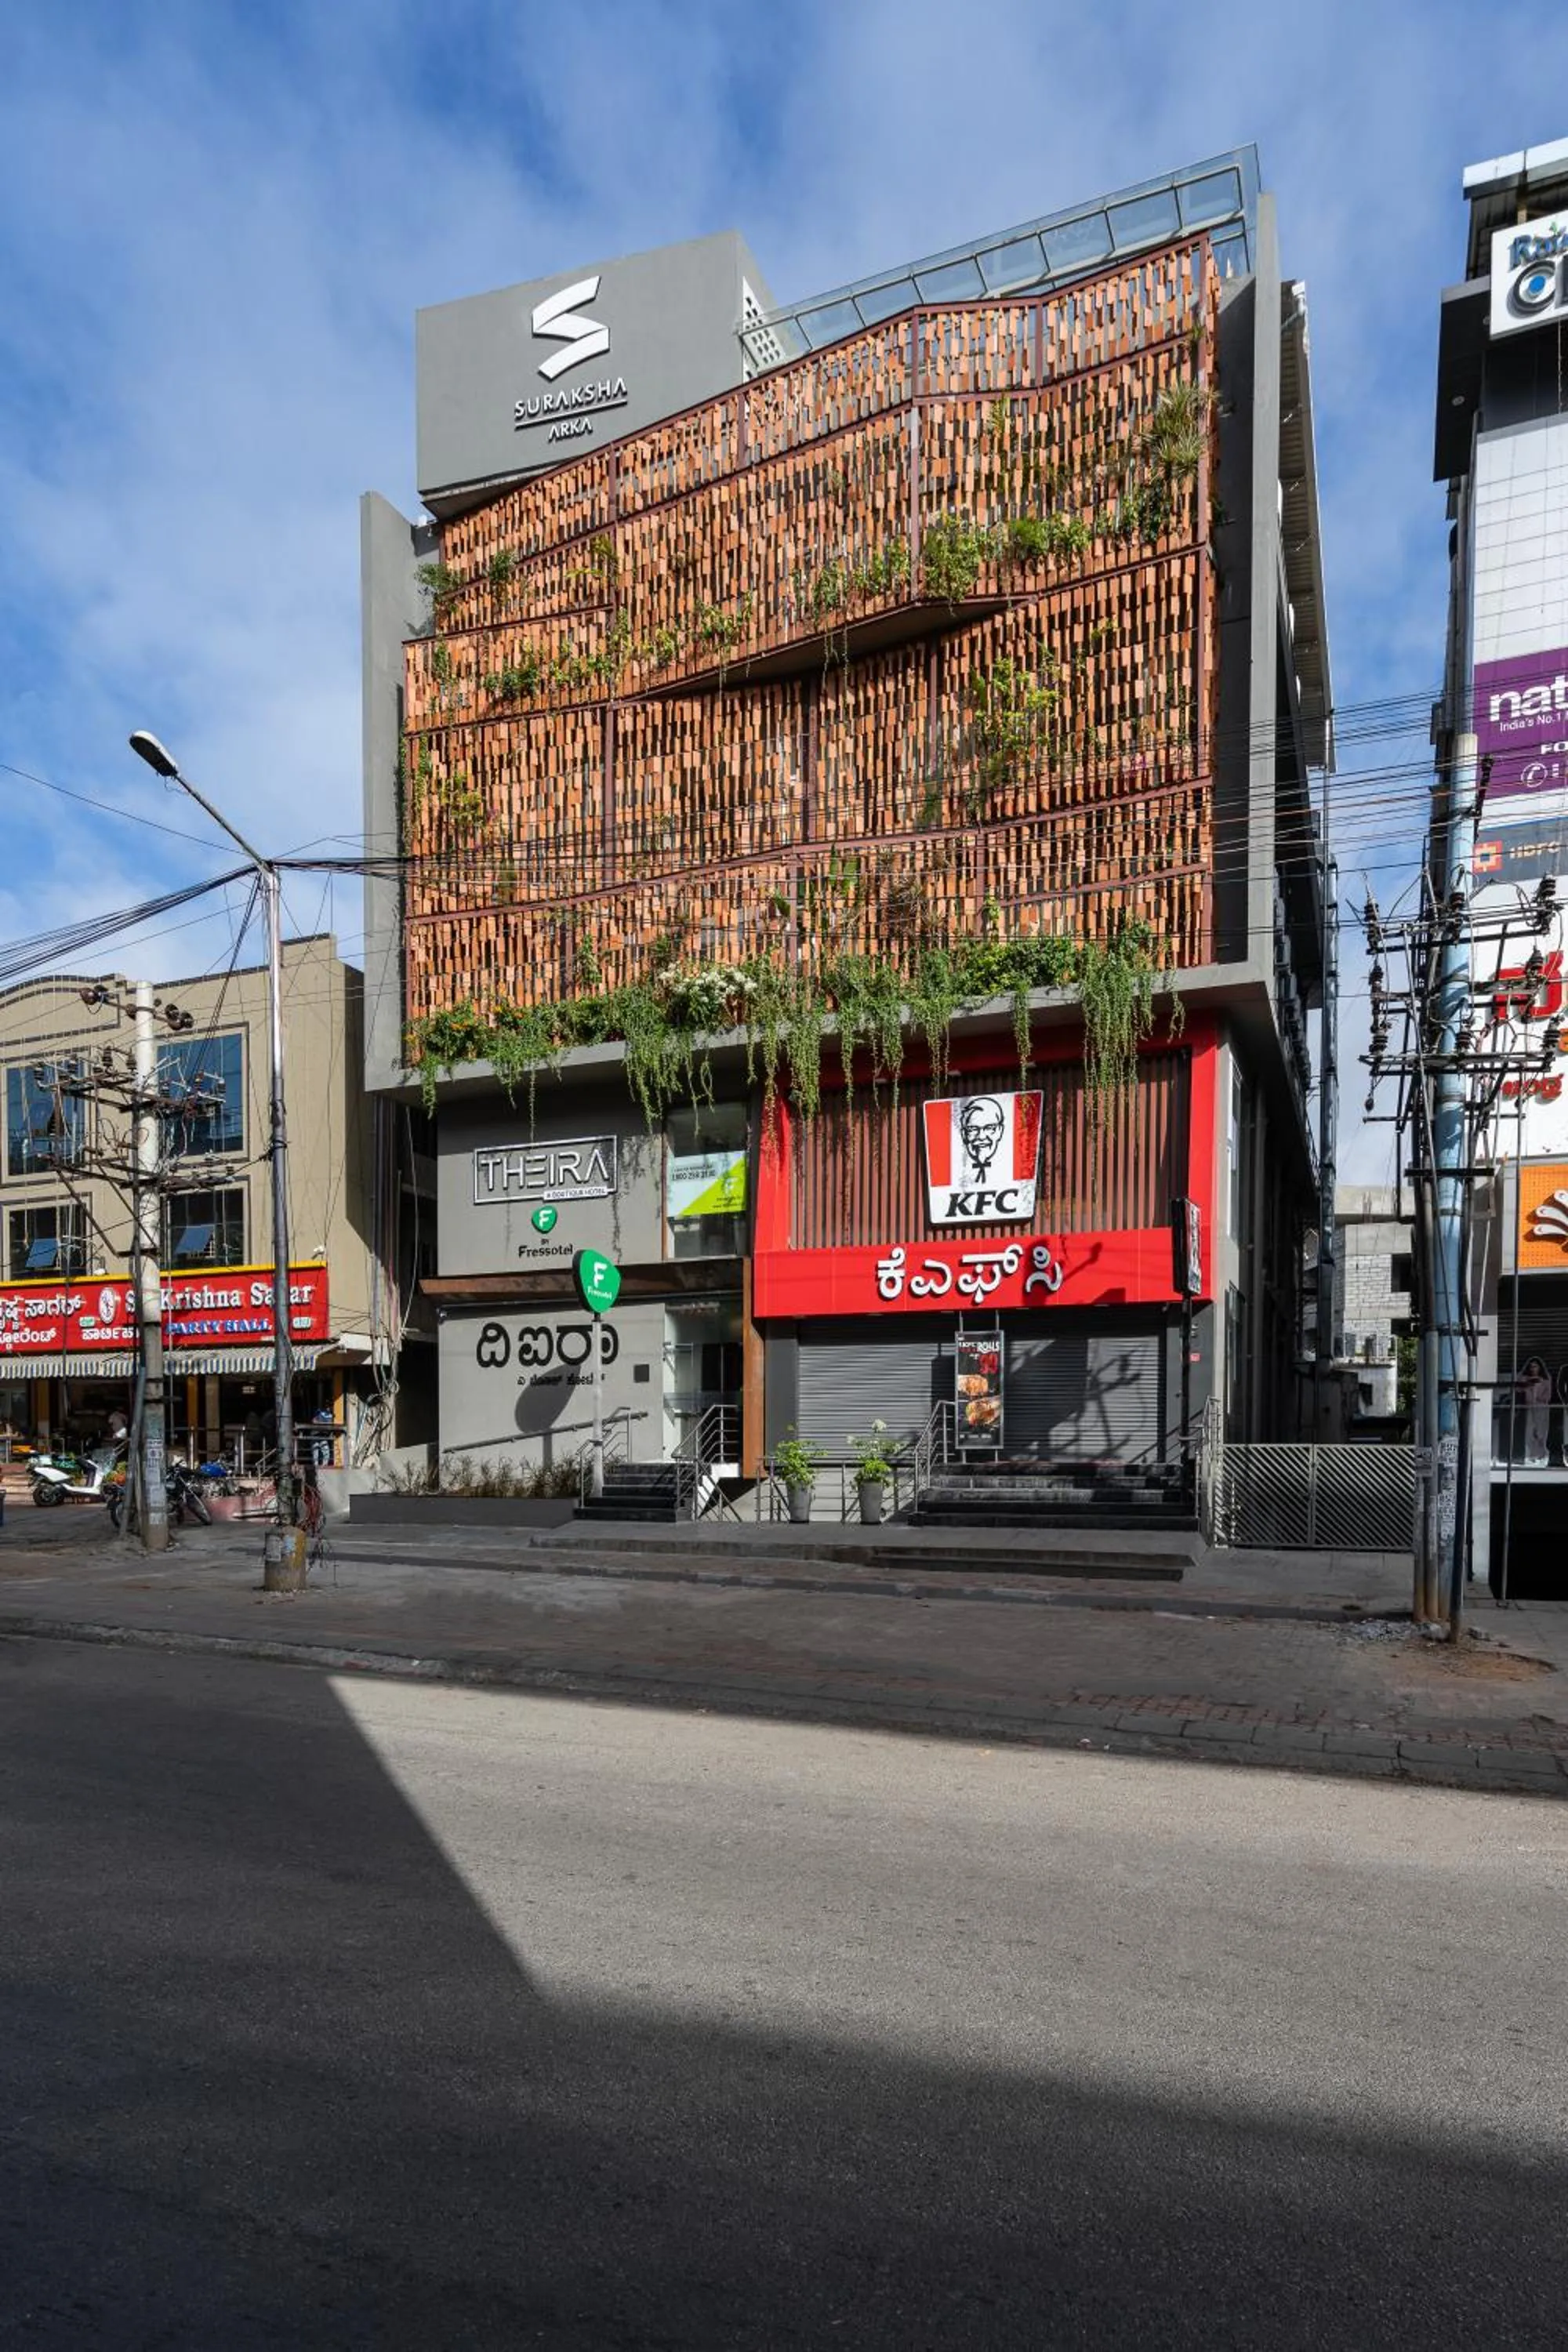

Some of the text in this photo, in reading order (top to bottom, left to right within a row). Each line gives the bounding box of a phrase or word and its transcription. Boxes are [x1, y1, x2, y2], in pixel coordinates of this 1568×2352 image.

[514, 377, 627, 420] SURAKSHA
[549, 418, 593, 442] ARKA
[1500, 712, 1561, 732] India's No.1
[481, 1149, 609, 1191] THEIRA
[946, 1189, 1018, 1217] KFC
[518, 1243, 573, 1258] Fressotel
[160, 1286, 242, 1310] Krishna
[249, 1282, 313, 1307] Saar
[165, 1317, 273, 1335] PARTY HALL
